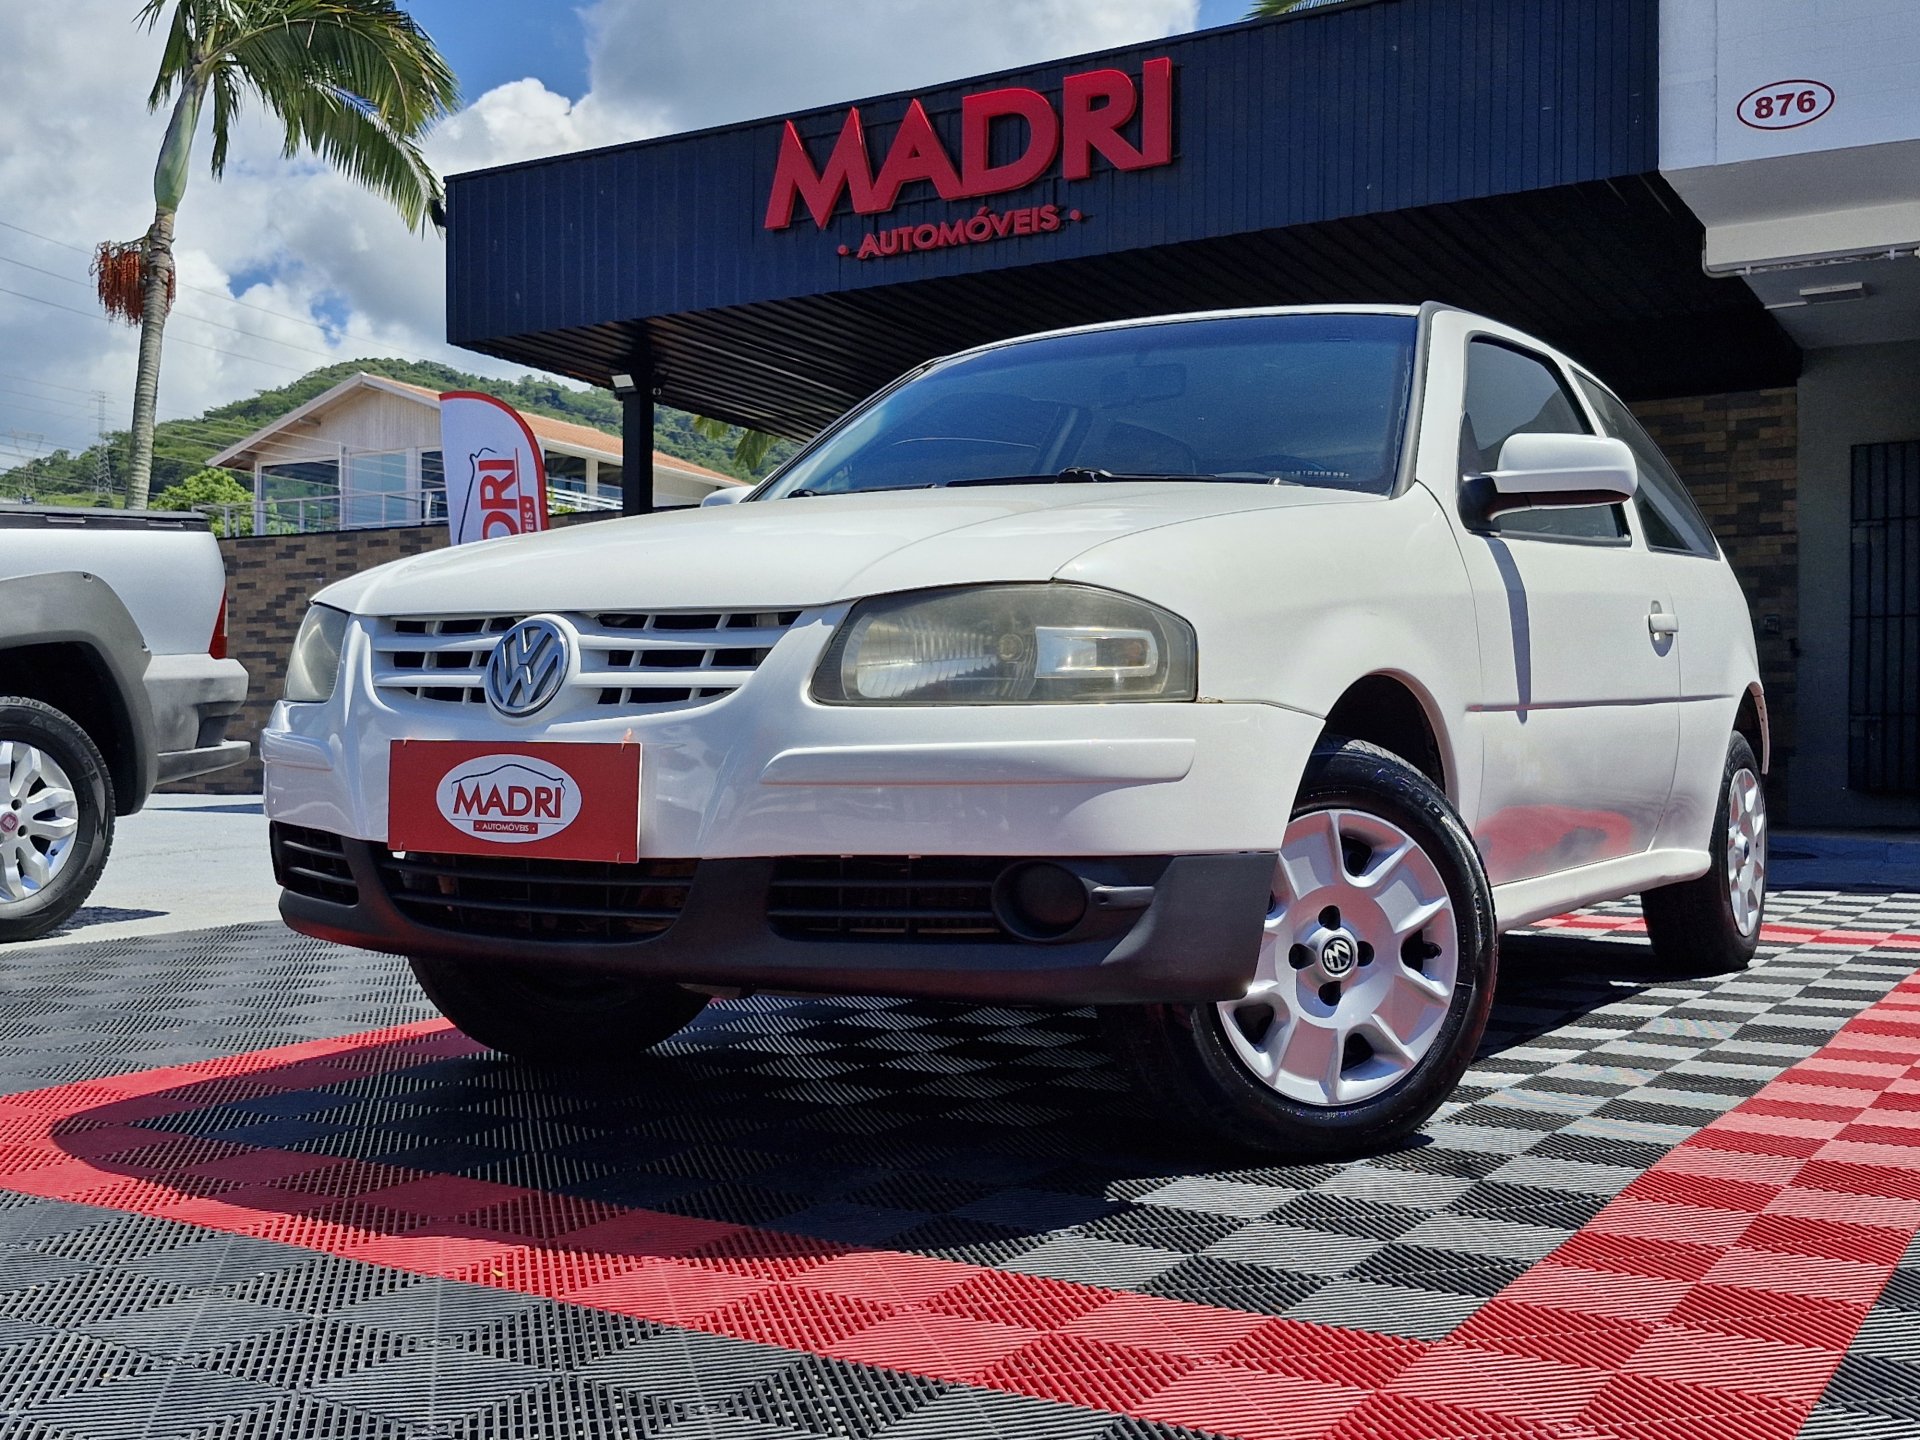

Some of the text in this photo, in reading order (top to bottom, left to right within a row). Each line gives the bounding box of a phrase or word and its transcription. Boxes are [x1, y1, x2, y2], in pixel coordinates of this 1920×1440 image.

[1754, 90, 1816, 119] 876
[764, 57, 1172, 230] MADRI
[857, 204, 1061, 260] AUTOMÓVEIS
[453, 781, 562, 819] MADRI
[481, 822, 530, 833] AUTOMÓVEIS
